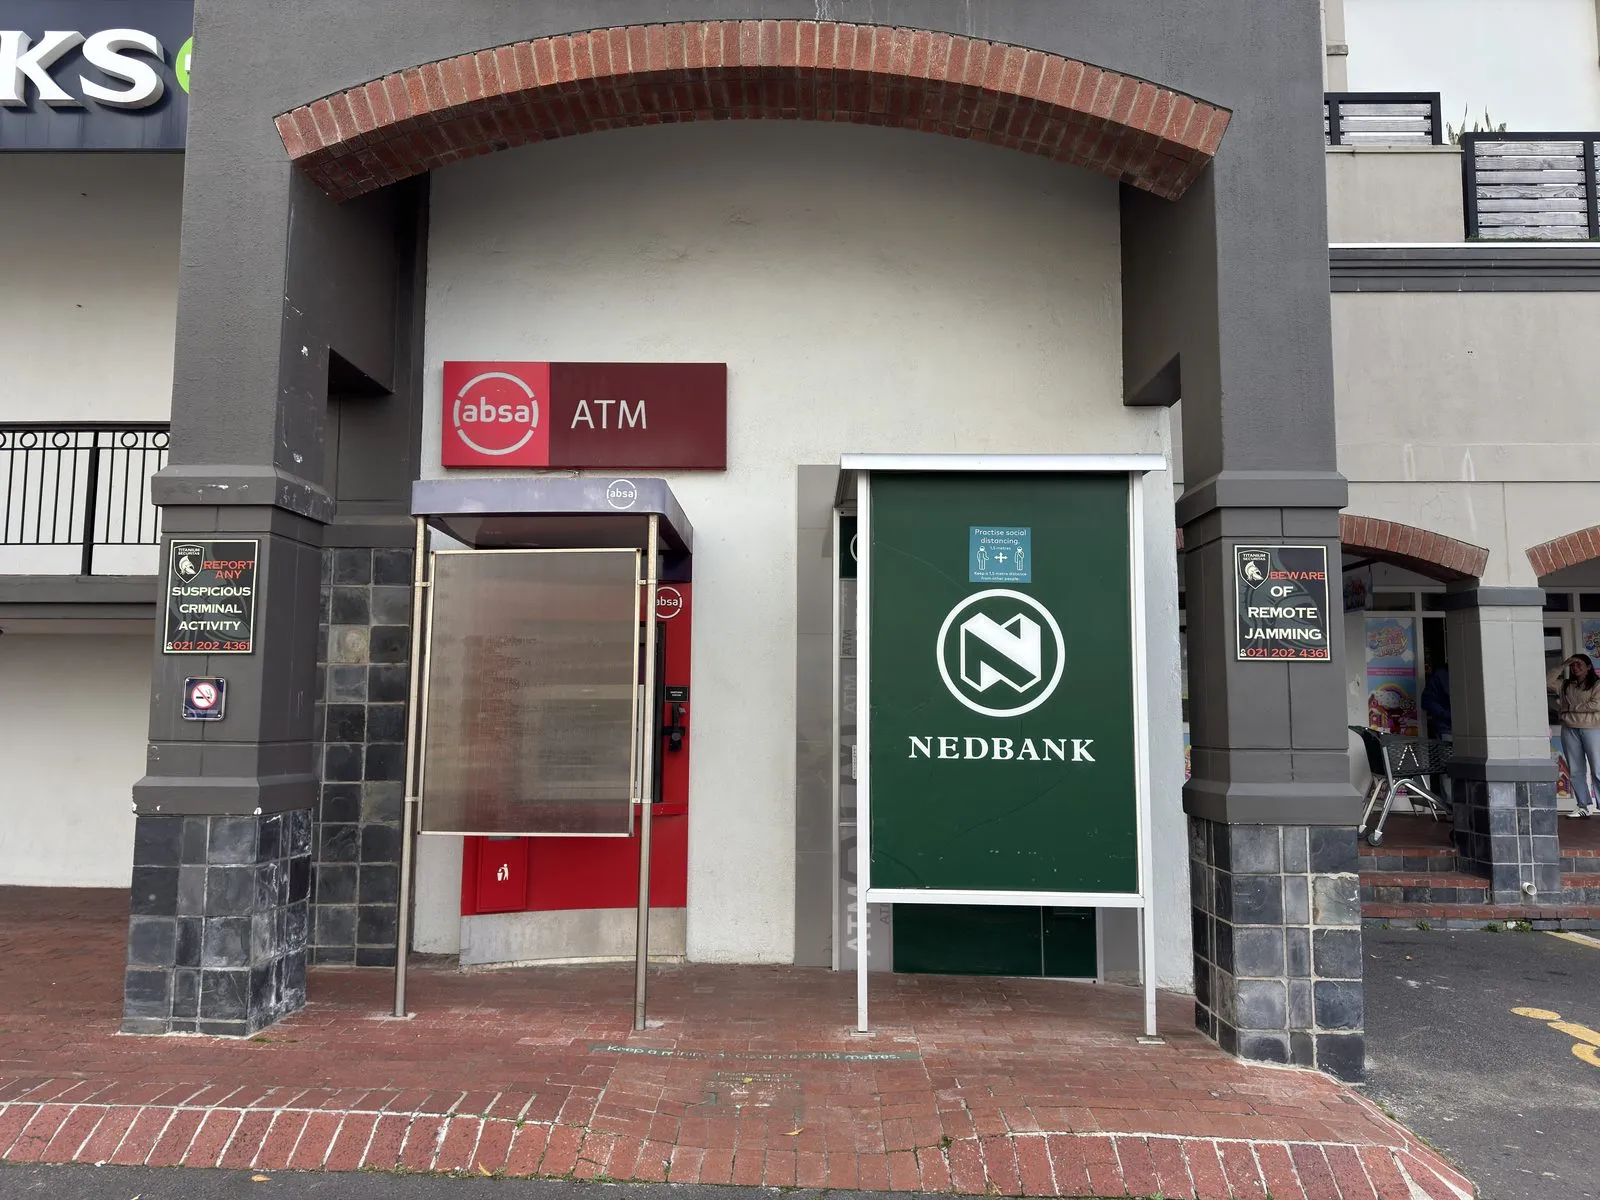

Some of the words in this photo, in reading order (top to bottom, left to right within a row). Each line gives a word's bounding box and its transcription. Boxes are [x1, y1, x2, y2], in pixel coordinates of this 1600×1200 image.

[462, 397, 530, 423] absa
[571, 399, 647, 430] ATM
[609, 487, 634, 499] absa
[974, 528, 1004, 536] Practise
[203, 560, 255, 570] REPORT
[215, 570, 242, 579] ANY
[1269, 571, 1326, 580] BEWARE
[172, 586, 251, 596] SUSPICIOUS
[1270, 585, 1294, 597] OF
[179, 603, 243, 614] CRIMINAL
[1248, 606, 1317, 619] REMOTE
[178, 620, 241, 631] ACTIVITY
[1244, 628, 1322, 640] JAMMING
[173, 641, 194, 650] 021
[196, 641, 219, 650] 202
[222, 641, 250, 650] 4361
[841, 629, 853, 656] ATM
[1247, 648, 1267, 657] 021
[1271, 648, 1296, 657] 202
[1299, 649, 1328, 658] 4361
[843, 675, 857, 715] ATM
[908, 736, 1096, 763] NEDBANK
[880, 903, 890, 925] AT
[607, 1044, 644, 1055] Keep
